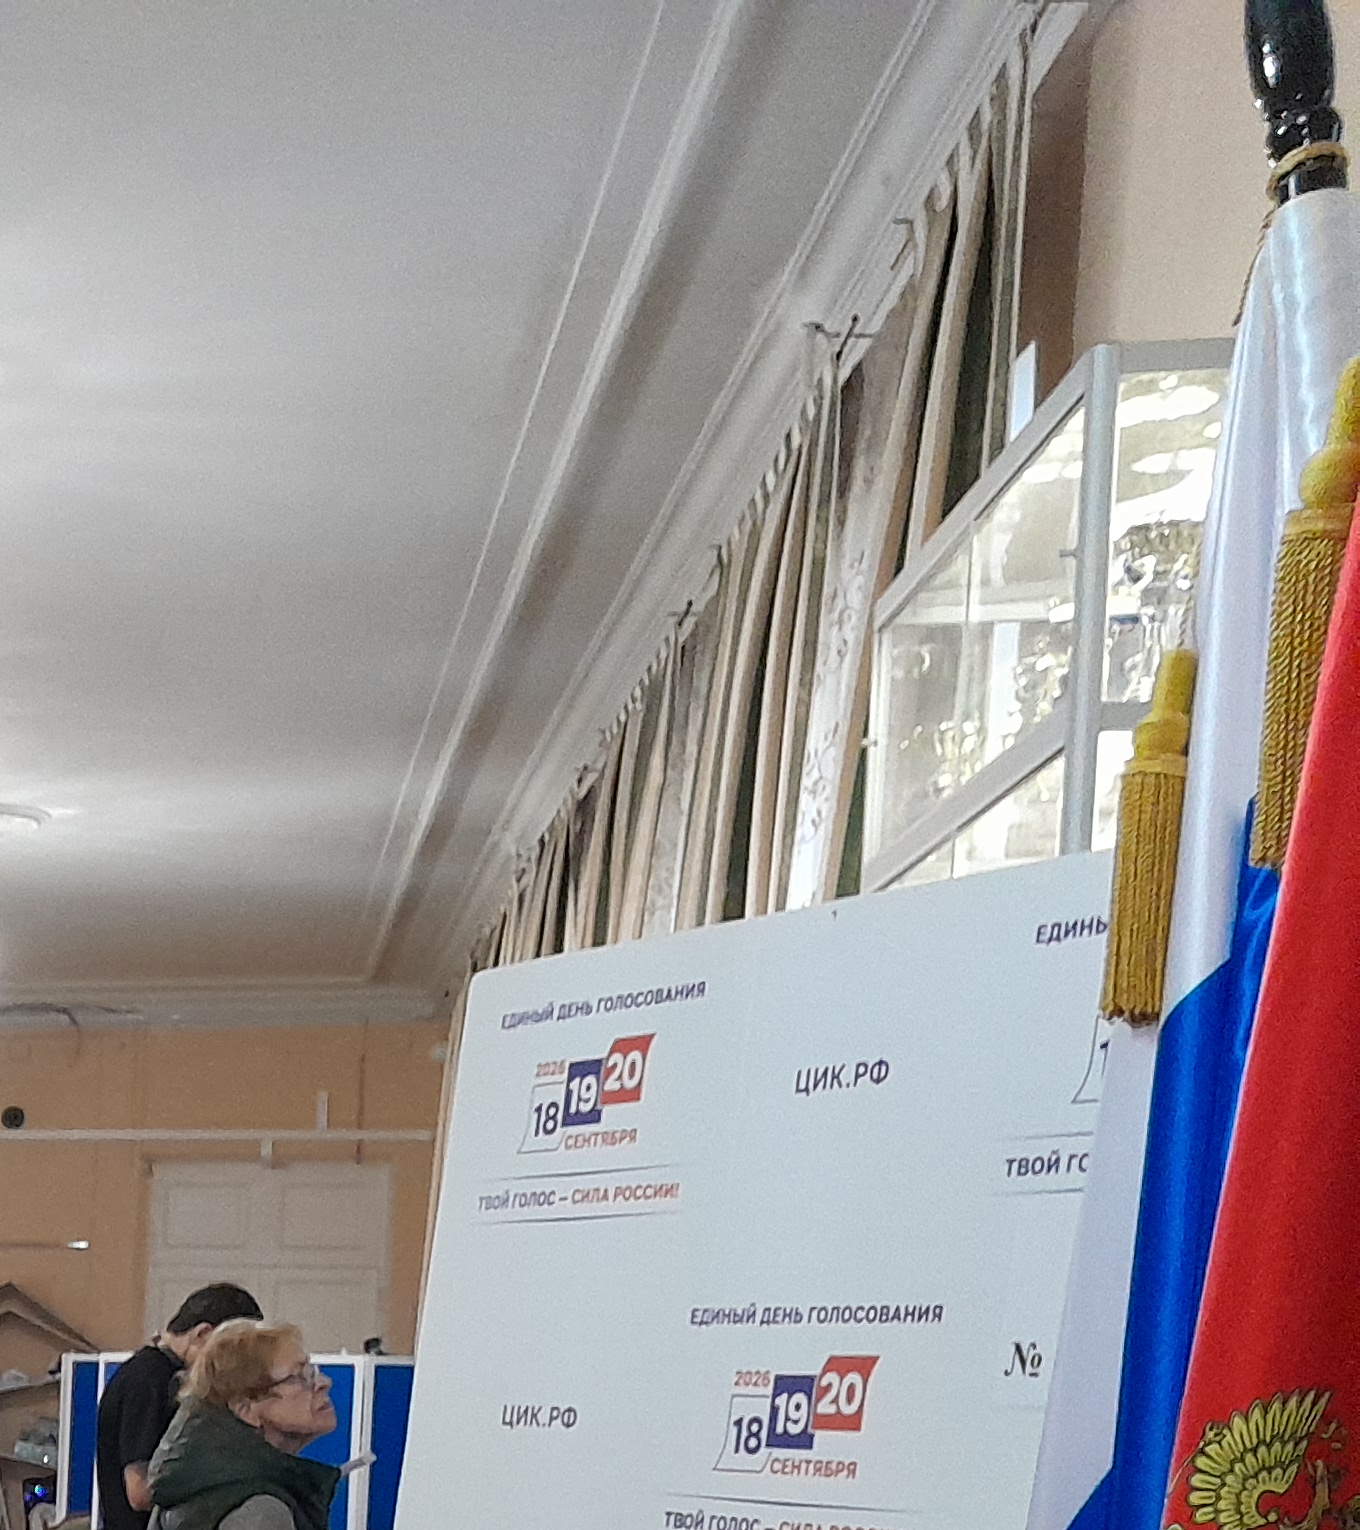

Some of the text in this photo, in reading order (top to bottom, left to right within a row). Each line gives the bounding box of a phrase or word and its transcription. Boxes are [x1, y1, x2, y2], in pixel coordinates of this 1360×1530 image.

[1036, 916, 1108, 945] ЕДИНЫ
[557, 1000, 593, 1022] ДЕНЬ
[596, 981, 706, 1013] ГОЛОСОВАНИЯ
[795, 1058, 890, 1095] ЦИК.РФ
[533, 1050, 643, 1137] 18 19 20
[564, 1128, 638, 1150] СЕНТЯБРЯ
[1005, 1149, 1060, 1178] ТВОЙ
[511, 1190, 556, 1209] ГОЛОС
[571, 1188, 610, 1206] СИЛА
[613, 1182, 680, 1202] РОССИИ!
[690, 1303, 944, 1327] ЕДИНЫЙ ДЕНЬ ГОЛОСОВАНИЯ
[1004, 1341, 1042, 1378] №
[501, 1404, 577, 1429] ЦИК.РФ
[732, 1371, 863, 1455] 18 19 20
[769, 1457, 858, 1480] СЕНТЯБРЯ
[664, 1509, 704, 1530] ТВОЙ
